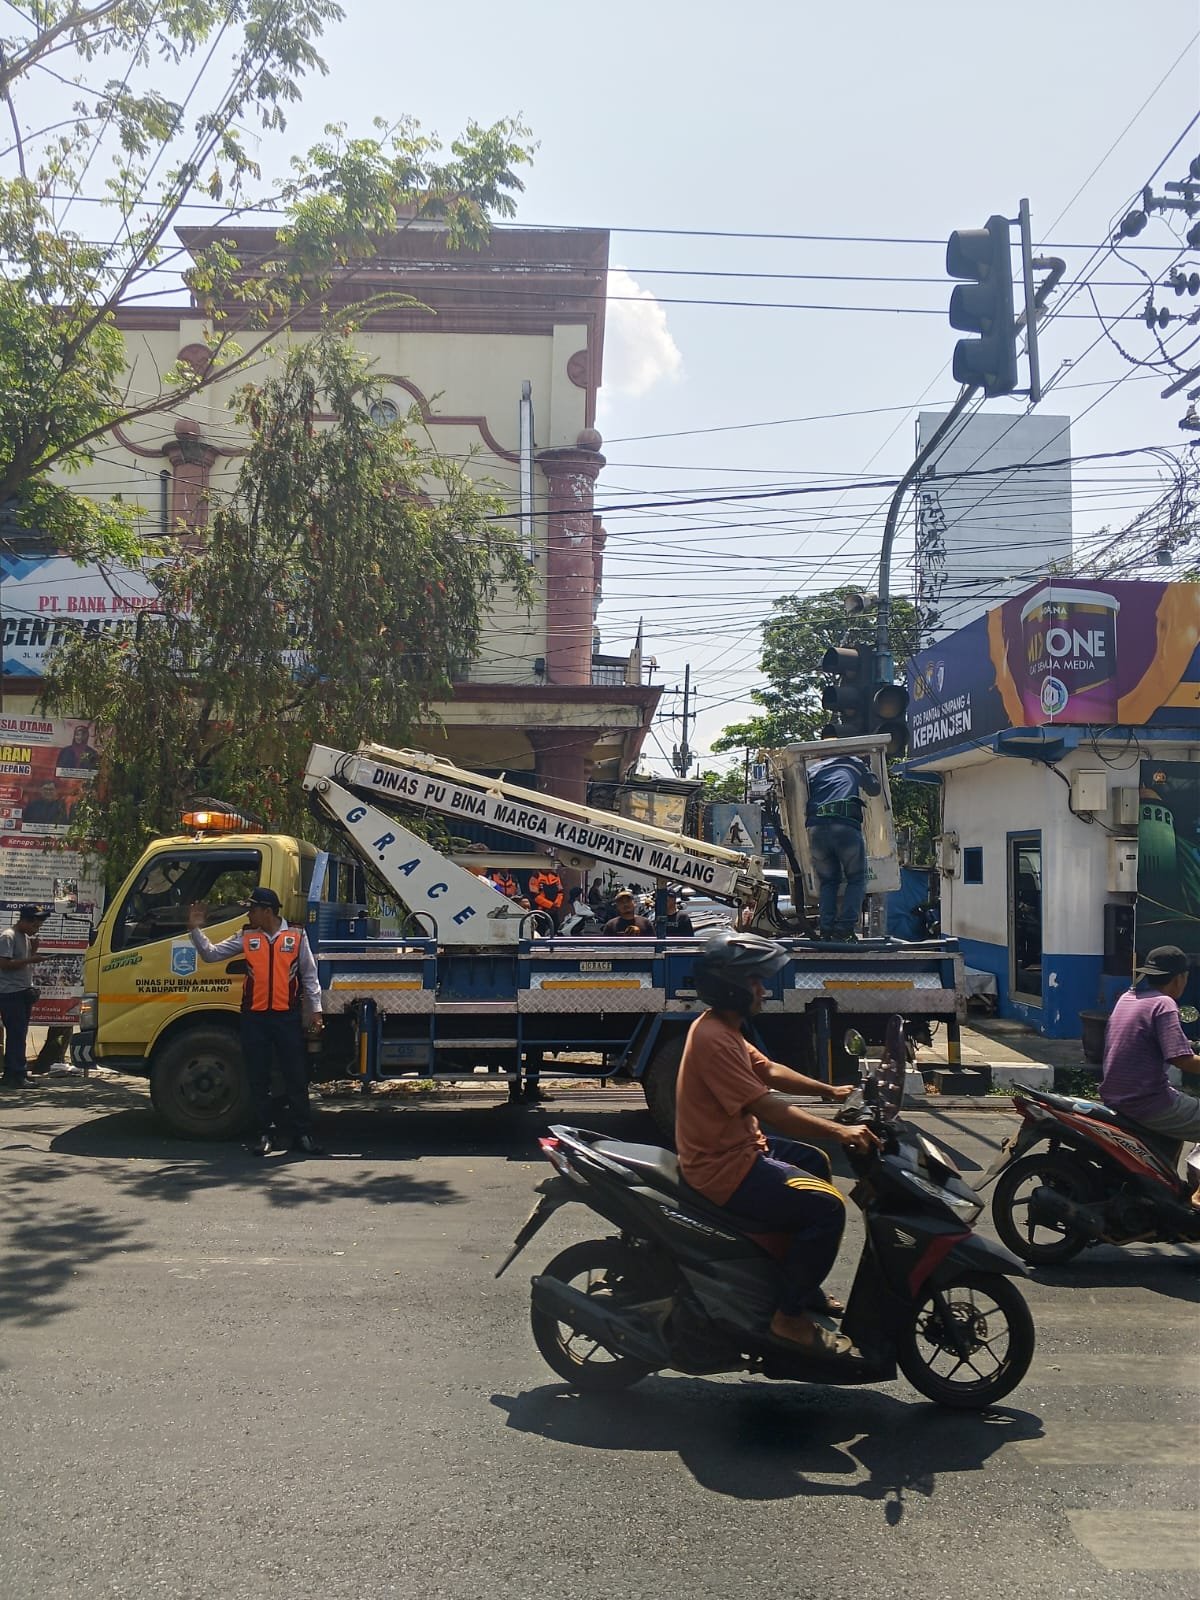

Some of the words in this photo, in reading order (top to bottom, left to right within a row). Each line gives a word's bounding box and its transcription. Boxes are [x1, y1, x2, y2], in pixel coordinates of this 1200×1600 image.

[38, 596, 61, 612] PT.
[67, 596, 106, 613] BANK
[1046, 628, 1106, 658] ONE
[1064, 660, 1095, 670] MEDIA
[913, 713, 922, 728] POS
[941, 695, 965, 715] SIMPANG
[966, 692, 971, 706] 4
[20, 721, 53, 733] UTAMA
[913, 708, 972, 749] KEPANJEN
[372, 768, 419, 795] DINAS
[424, 784, 447, 802] PU
[451, 791, 486, 816] BINA
[494, 804, 547, 834] MARGA
[555, 822, 644, 862] KABUPATEN
[649, 851, 715, 883] MALANG
